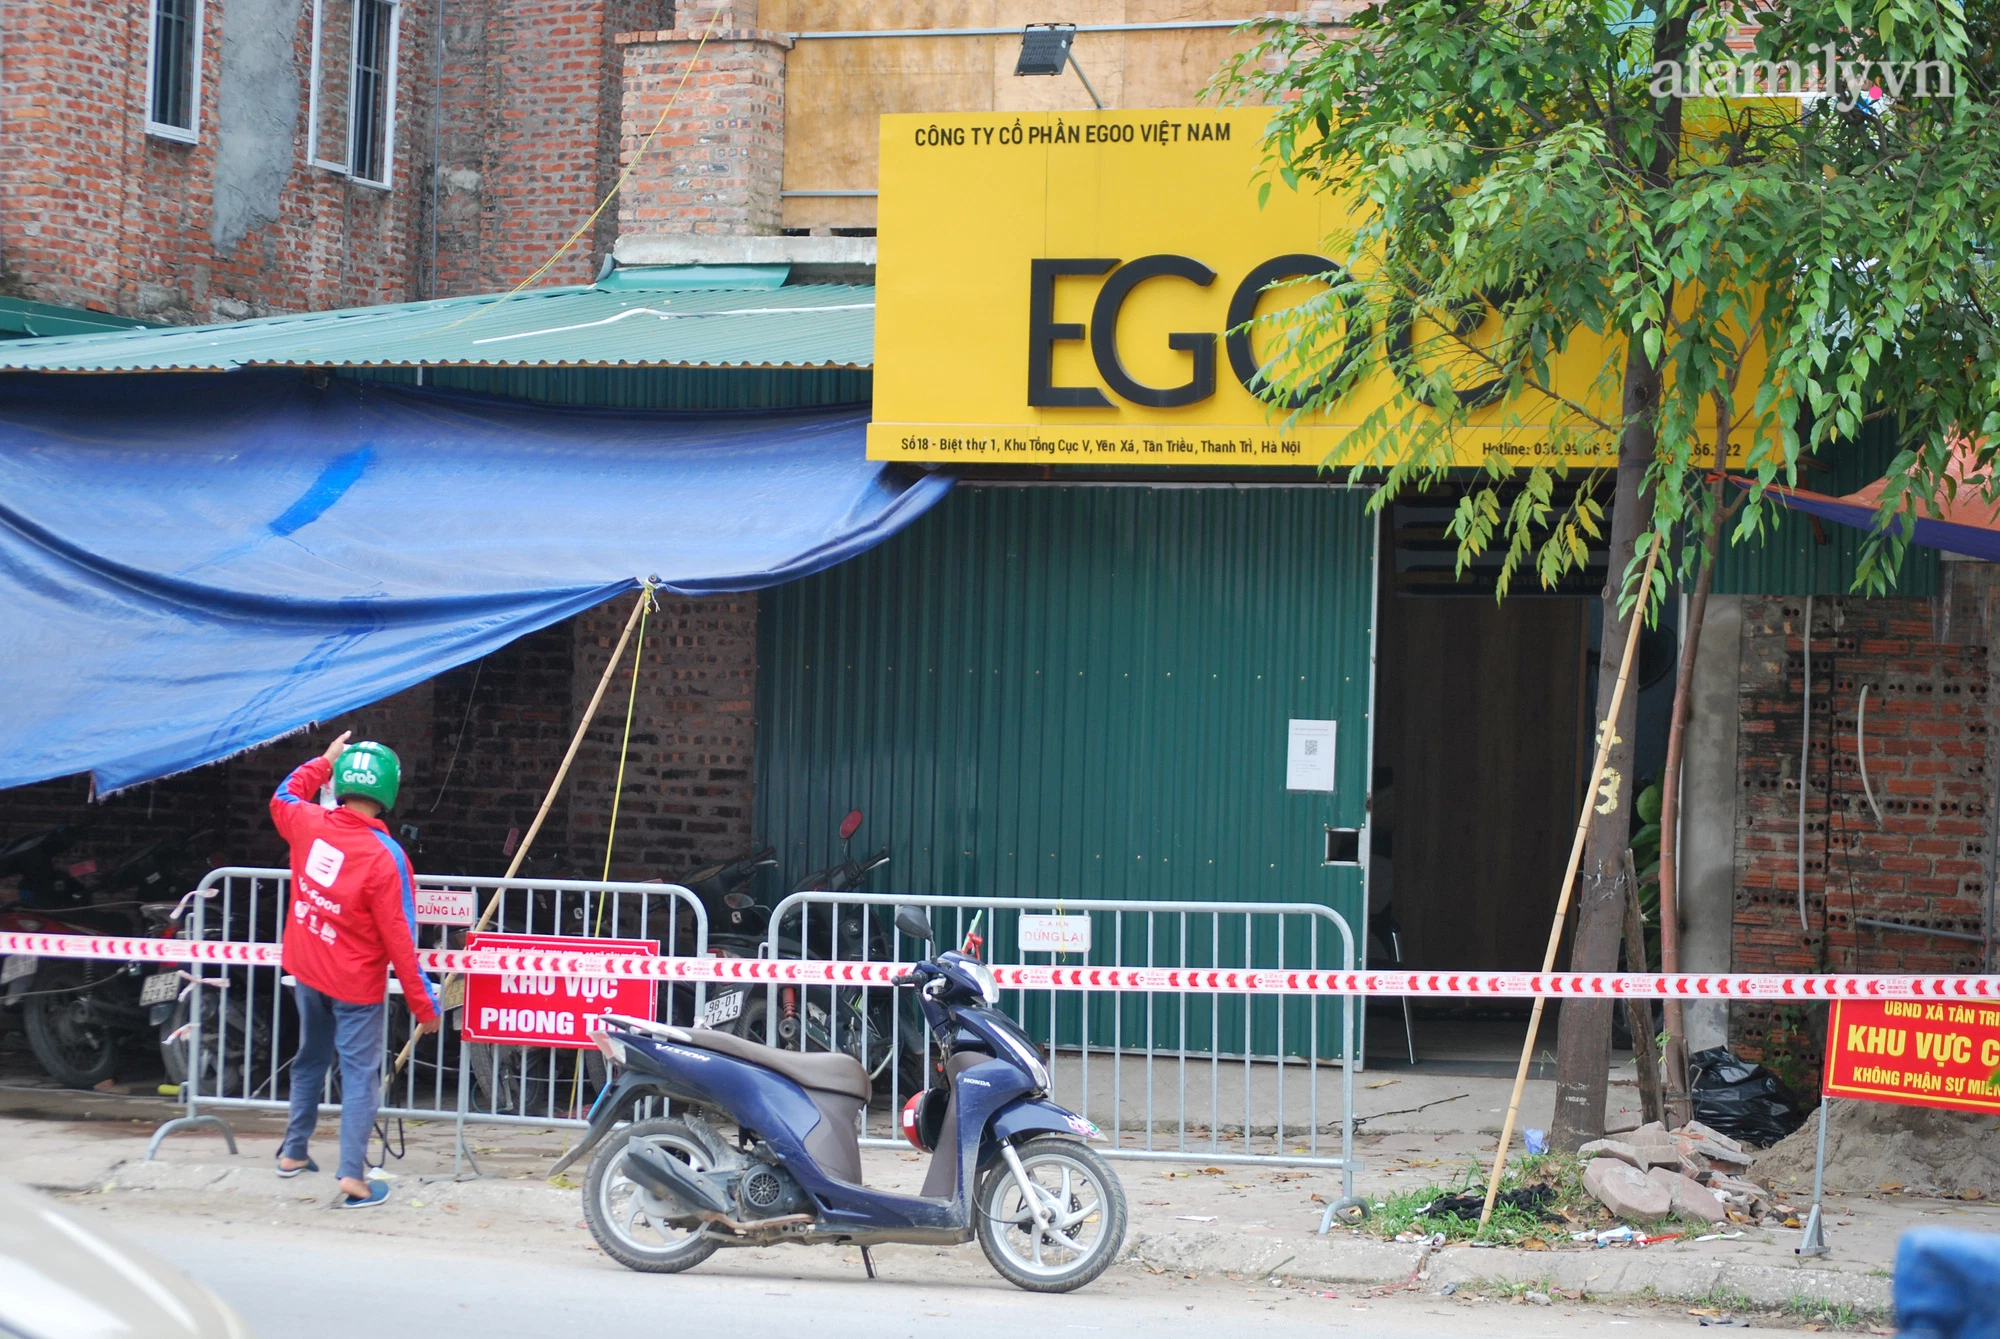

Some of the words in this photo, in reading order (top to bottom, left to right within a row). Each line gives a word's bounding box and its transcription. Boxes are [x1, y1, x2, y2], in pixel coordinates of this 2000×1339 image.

[915, 124, 965, 146] CÔNG
[971, 127, 995, 145] TY
[999, 117, 1023, 145] CỔ
[1028, 117, 1080, 144] PHẦN
[1086, 124, 1135, 143] EGOO
[1140, 120, 1181, 146] VIỆT
[1187, 122, 1231, 142] NAM
[939, 438, 963, 453] Biệt
[966, 438, 987, 454] thự
[990, 438, 1000, 452] 1,
[1004, 438, 1027, 451] Khu
[1029, 436, 1055, 454] Tổng
[1057, 439, 1079, 454] Cục
[1081, 439, 1093, 454] V,
[1095, 439, 1116, 452] Yên
[1142, 439, 1163, 452] Tân
[1201, 440, 1236, 453] Thanh
[1261, 440, 1277, 453] Hà
[1281, 440, 1301, 456] Nội
[1482, 441, 1531, 456] Hotline:
[342, 769, 377, 785] Grab
[417, 902, 449, 916] DỪNG
[451, 906, 470, 919] LẠI
[500, 974, 556, 997] KHU
[708, 994, 737, 1013] 98-D1
[1884, 1000, 1922, 1019] UBND
[1925, 1003, 1944, 1021] XÃ
[1948, 1005, 1975, 1024] TÂN
[480, 1007, 575, 1036] PHONG
[1847, 1024, 1906, 1056] KHU
[1915, 1031, 1972, 1067] VỰC
[963, 1077, 991, 1087] HONDA
[1853, 1065, 1900, 1086] KHÔNG
[1903, 1071, 1942, 1092] PHẬN
[1945, 1076, 1966, 1096] SỰ
